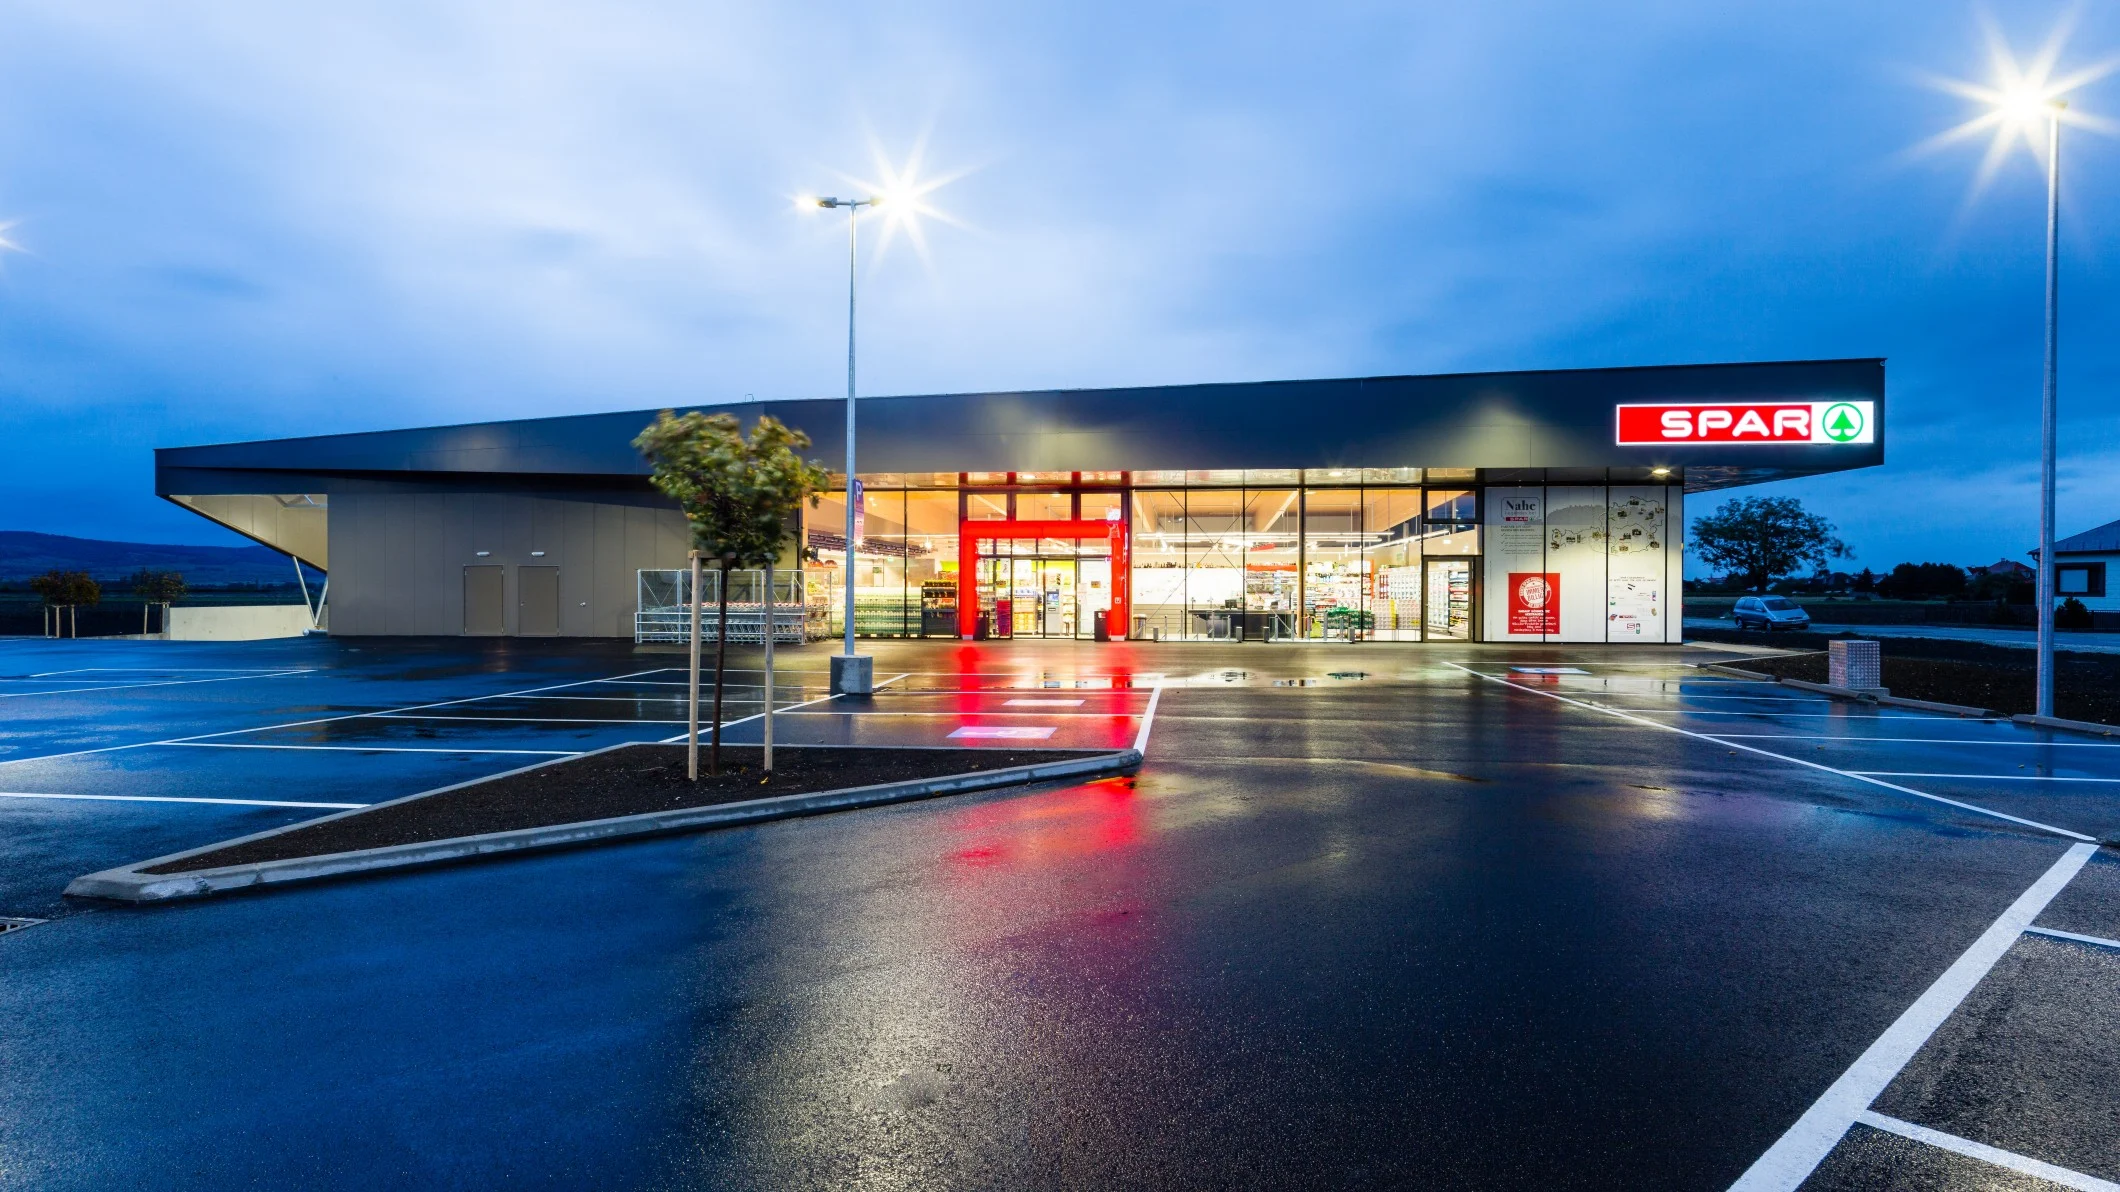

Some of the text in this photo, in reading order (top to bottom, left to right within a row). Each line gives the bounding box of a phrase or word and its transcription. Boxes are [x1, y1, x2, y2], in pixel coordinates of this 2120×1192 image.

[1661, 409, 1809, 438] SPAR
[855, 481, 862, 500] P
[1504, 500, 1536, 511] Nahe
